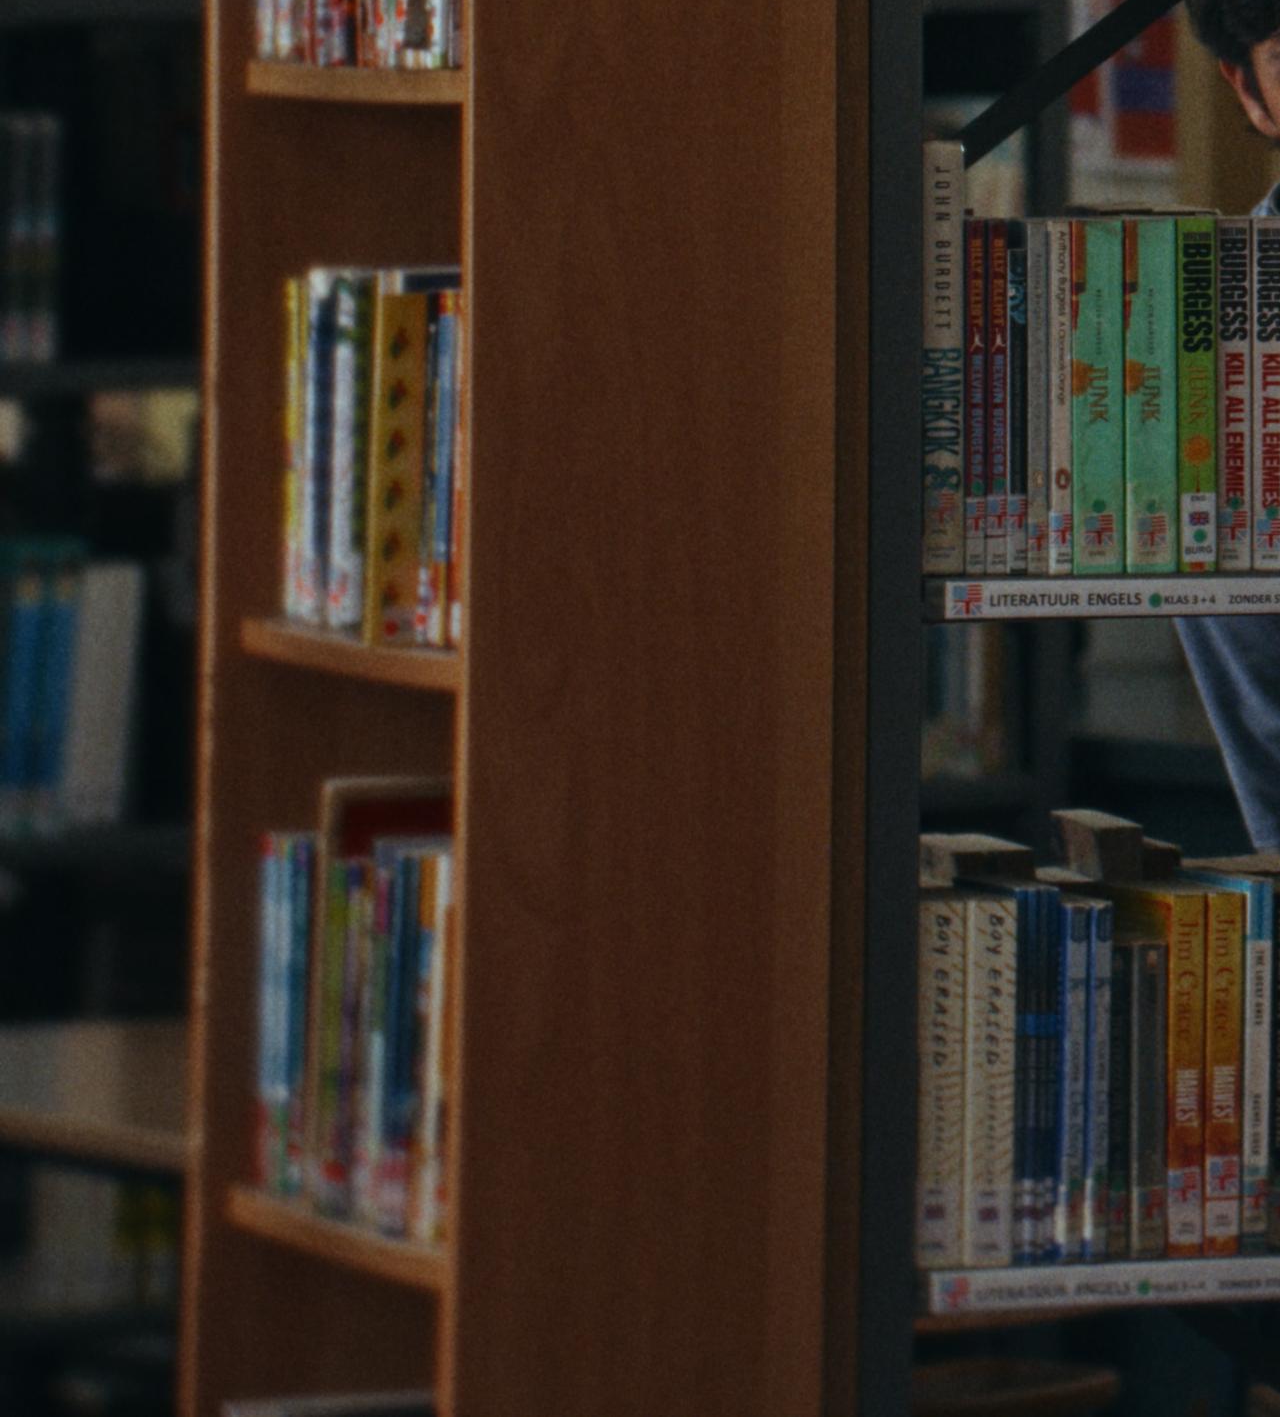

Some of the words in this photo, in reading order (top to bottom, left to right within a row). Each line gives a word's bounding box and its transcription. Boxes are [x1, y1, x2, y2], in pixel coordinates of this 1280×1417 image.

[935, 166, 951, 221] JOHN
[934, 241, 951, 329] BURDETT
[1182, 244, 1212, 353] BURGESS
[1220, 239, 1247, 340] BURGESS
[1089, 365, 1109, 423] JUNK
[1141, 365, 1161, 423] JUNK
[1187, 365, 1208, 424] JUNK
[1225, 353, 1243, 389] KILL
[1262, 353, 1280, 390] KILL
[922, 348, 960, 455] BANGKOK
[1225, 396, 1243, 426] ALL
[1262, 397, 1280, 426] ALL
[1225, 432, 1243, 498] ENEMIE
[1262, 433, 1280, 508] ENEMIES
[1185, 546, 1212, 555] BURG
[990, 593, 1078, 607] LITERATUUR
[1088, 593, 1142, 605] ENGELS
[1165, 594, 1190, 605] KLAS
[1192, 594, 1198, 605] 3
[1208, 594, 1216, 605] 4
[1229, 594, 1272, 604] ZONDER
[932, 914, 952, 955] BOY
[1178, 917, 1200, 961] Jim
[932, 969, 950, 1067] ERASED
[1178, 971, 1198, 1041] Crace
